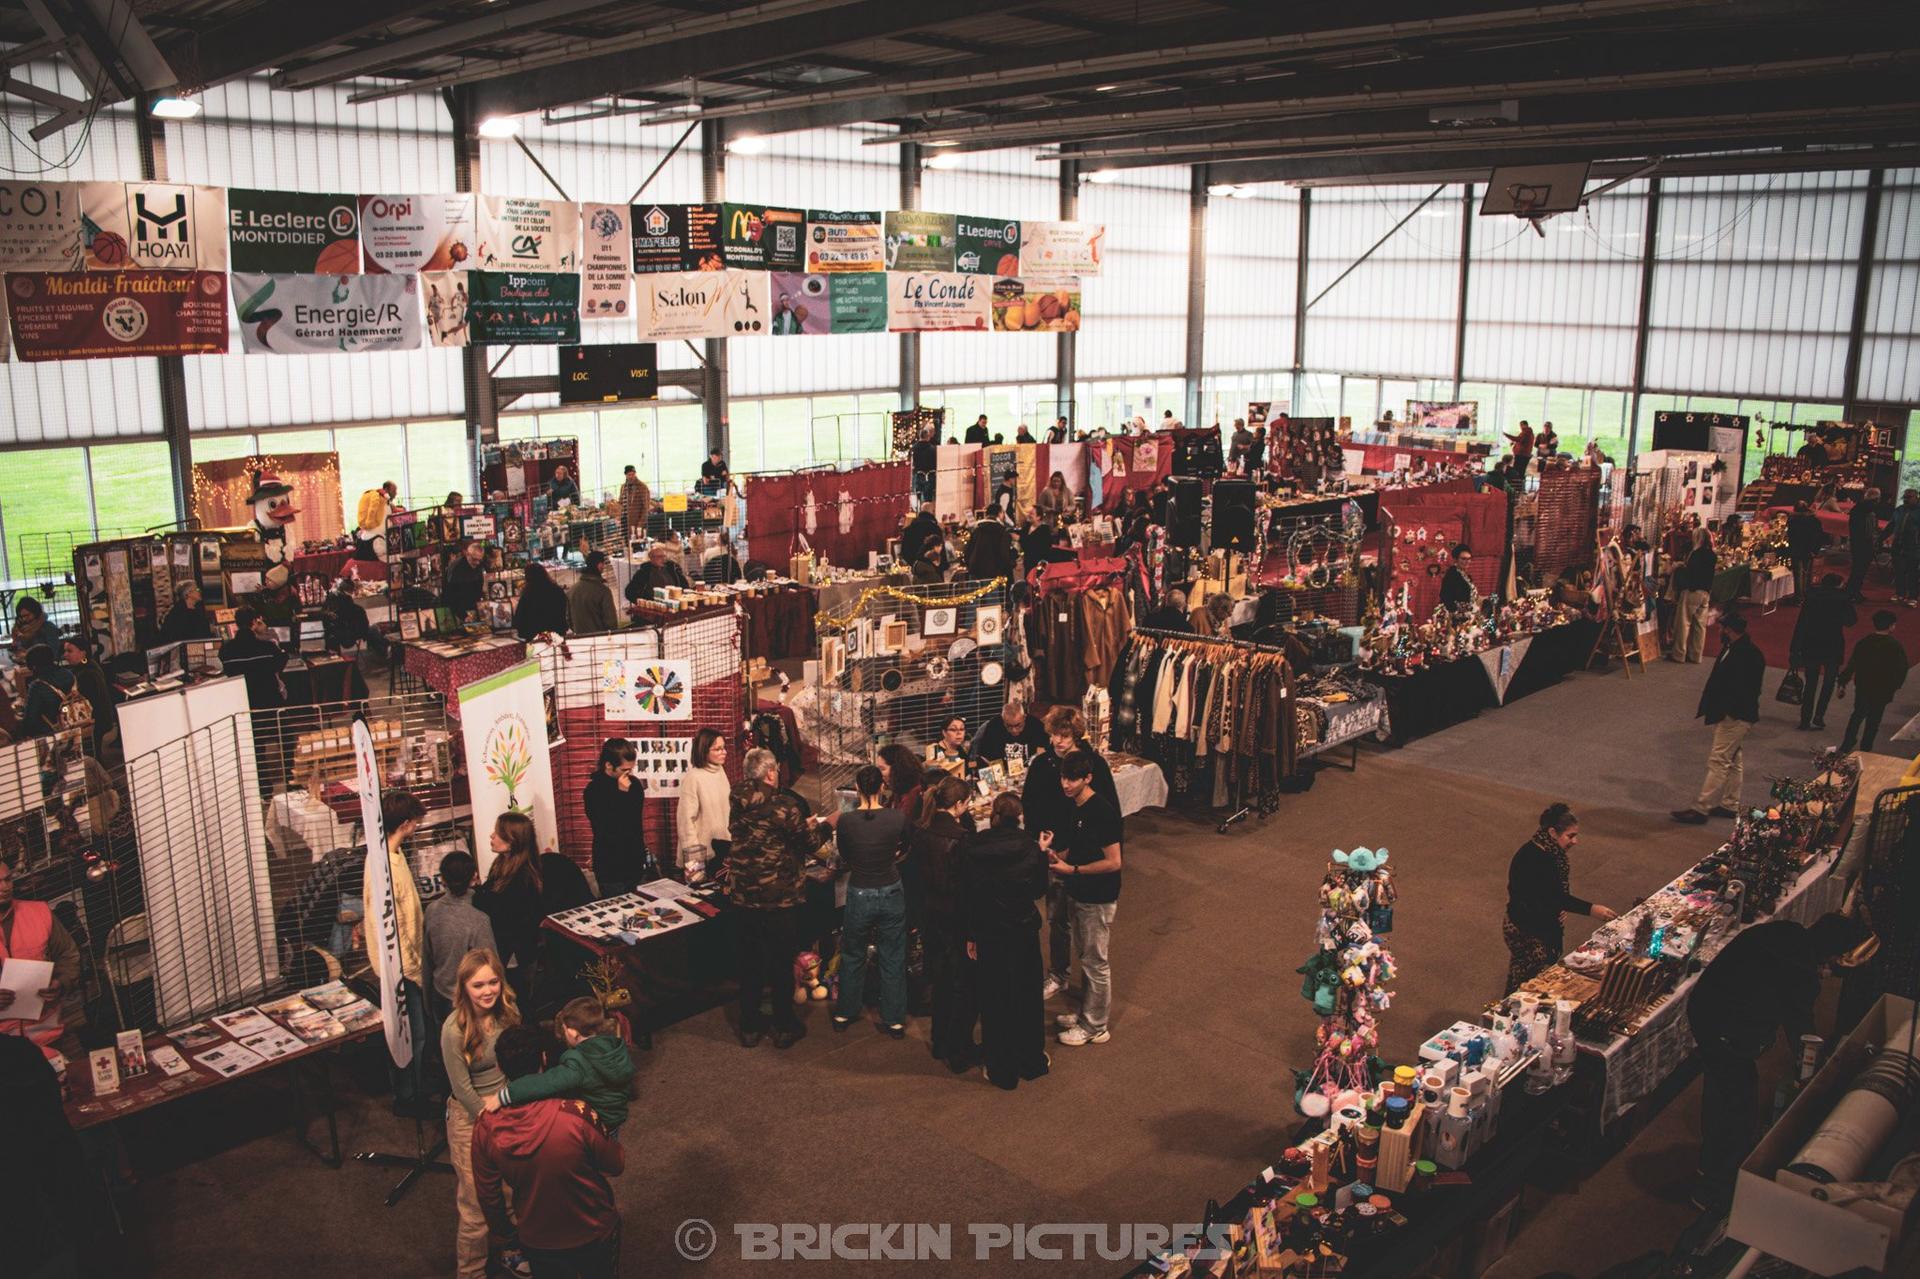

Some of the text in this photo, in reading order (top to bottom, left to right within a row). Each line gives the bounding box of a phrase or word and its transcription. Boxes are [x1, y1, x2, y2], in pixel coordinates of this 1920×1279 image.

[372, 198, 411, 221] Orpi
[232, 230, 326, 244] MONTDIDIER
[137, 242, 190, 258] HOAYI
[586, 263, 627, 272] CHAMPIONNES
[508, 274, 546, 288] Ippcom
[588, 273, 596, 281] DE
[605, 273, 627, 281] SOMME
[903, 275, 975, 299] Le Condé
[658, 287, 706, 308] Salon
[295, 303, 402, 328] Energie/R
[20, 332, 40, 340] VINS
[295, 327, 402, 338] Gérard Haemmerer
